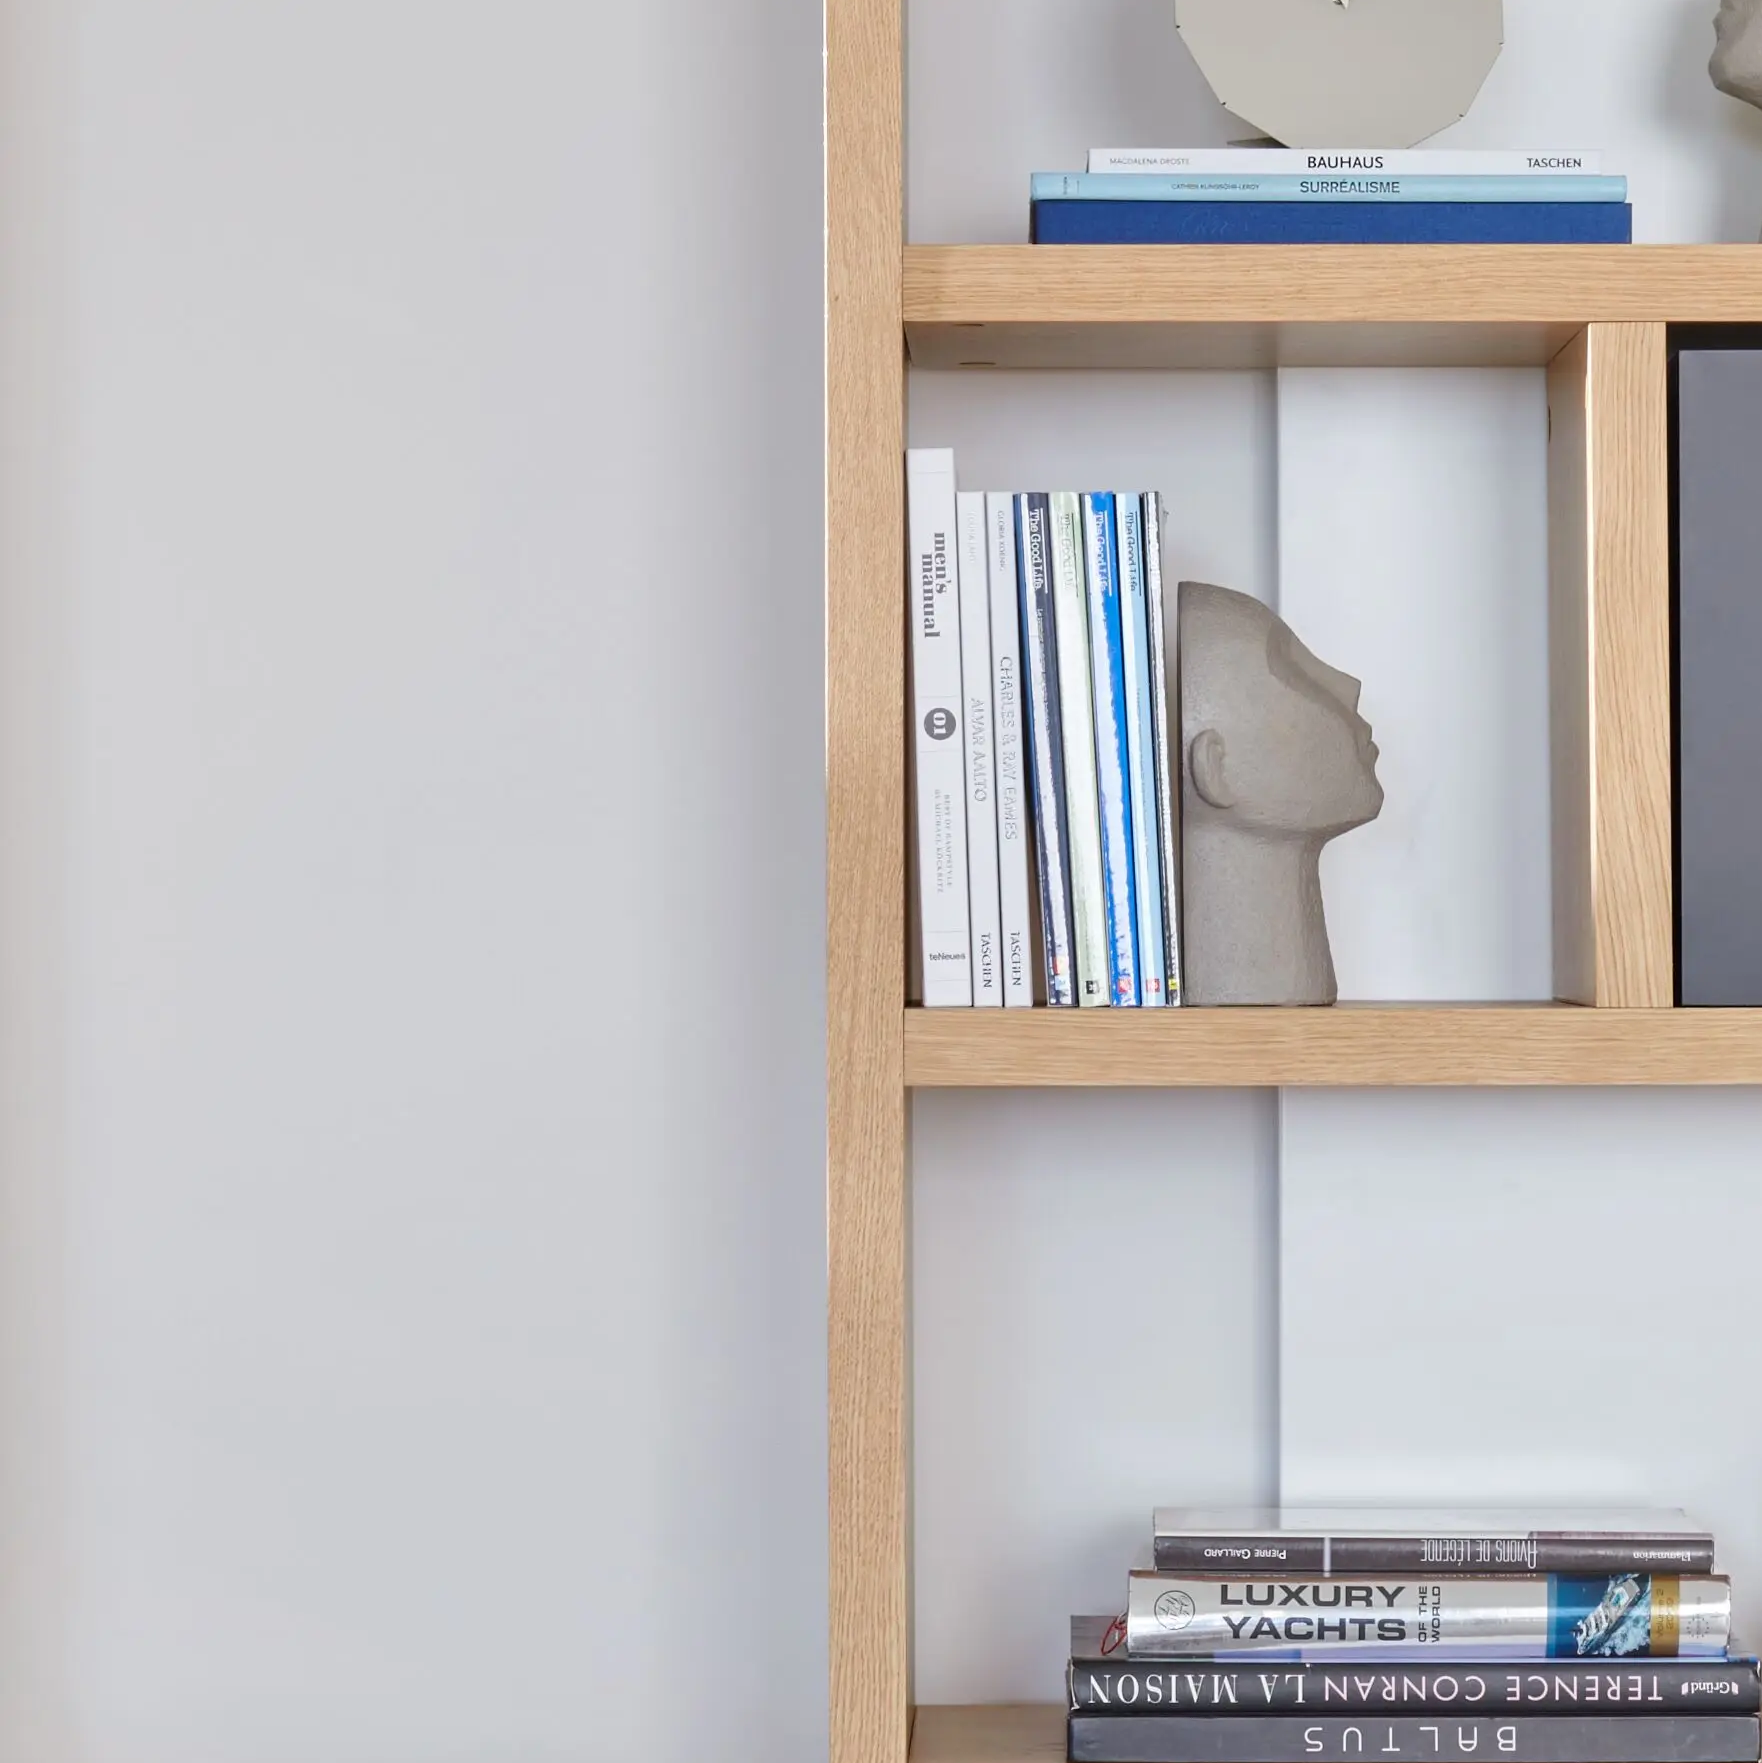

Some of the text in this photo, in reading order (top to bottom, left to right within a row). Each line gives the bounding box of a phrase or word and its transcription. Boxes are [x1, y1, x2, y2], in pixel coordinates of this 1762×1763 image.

[1307, 156, 1582, 169] BAUHAUS TASCHEN
[1300, 179, 1401, 194] SURRÉALISME
[1028, 508, 1041, 532] The
[1124, 511, 1135, 535] The
[1029, 533, 1042, 564] Good
[1126, 537, 1137, 566] Good
[934, 532, 951, 594] men's
[921, 553, 941, 639] manual
[932, 712, 947, 736] 01
[1220, 1584, 1406, 1608] LUXURY
[1418, 1585, 1428, 1643] OF THE
[1431, 1585, 1441, 1643] WORLD
[1222, 1616, 1406, 1641] YACHTS
[1087, 1674, 1306, 1704] LA MAISON
[1324, 1675, 1664, 1702] TERENCE CONRAN
[1691, 1681, 1730, 1696] Gründ
[1304, 1726, 1517, 1752] BALTUS
